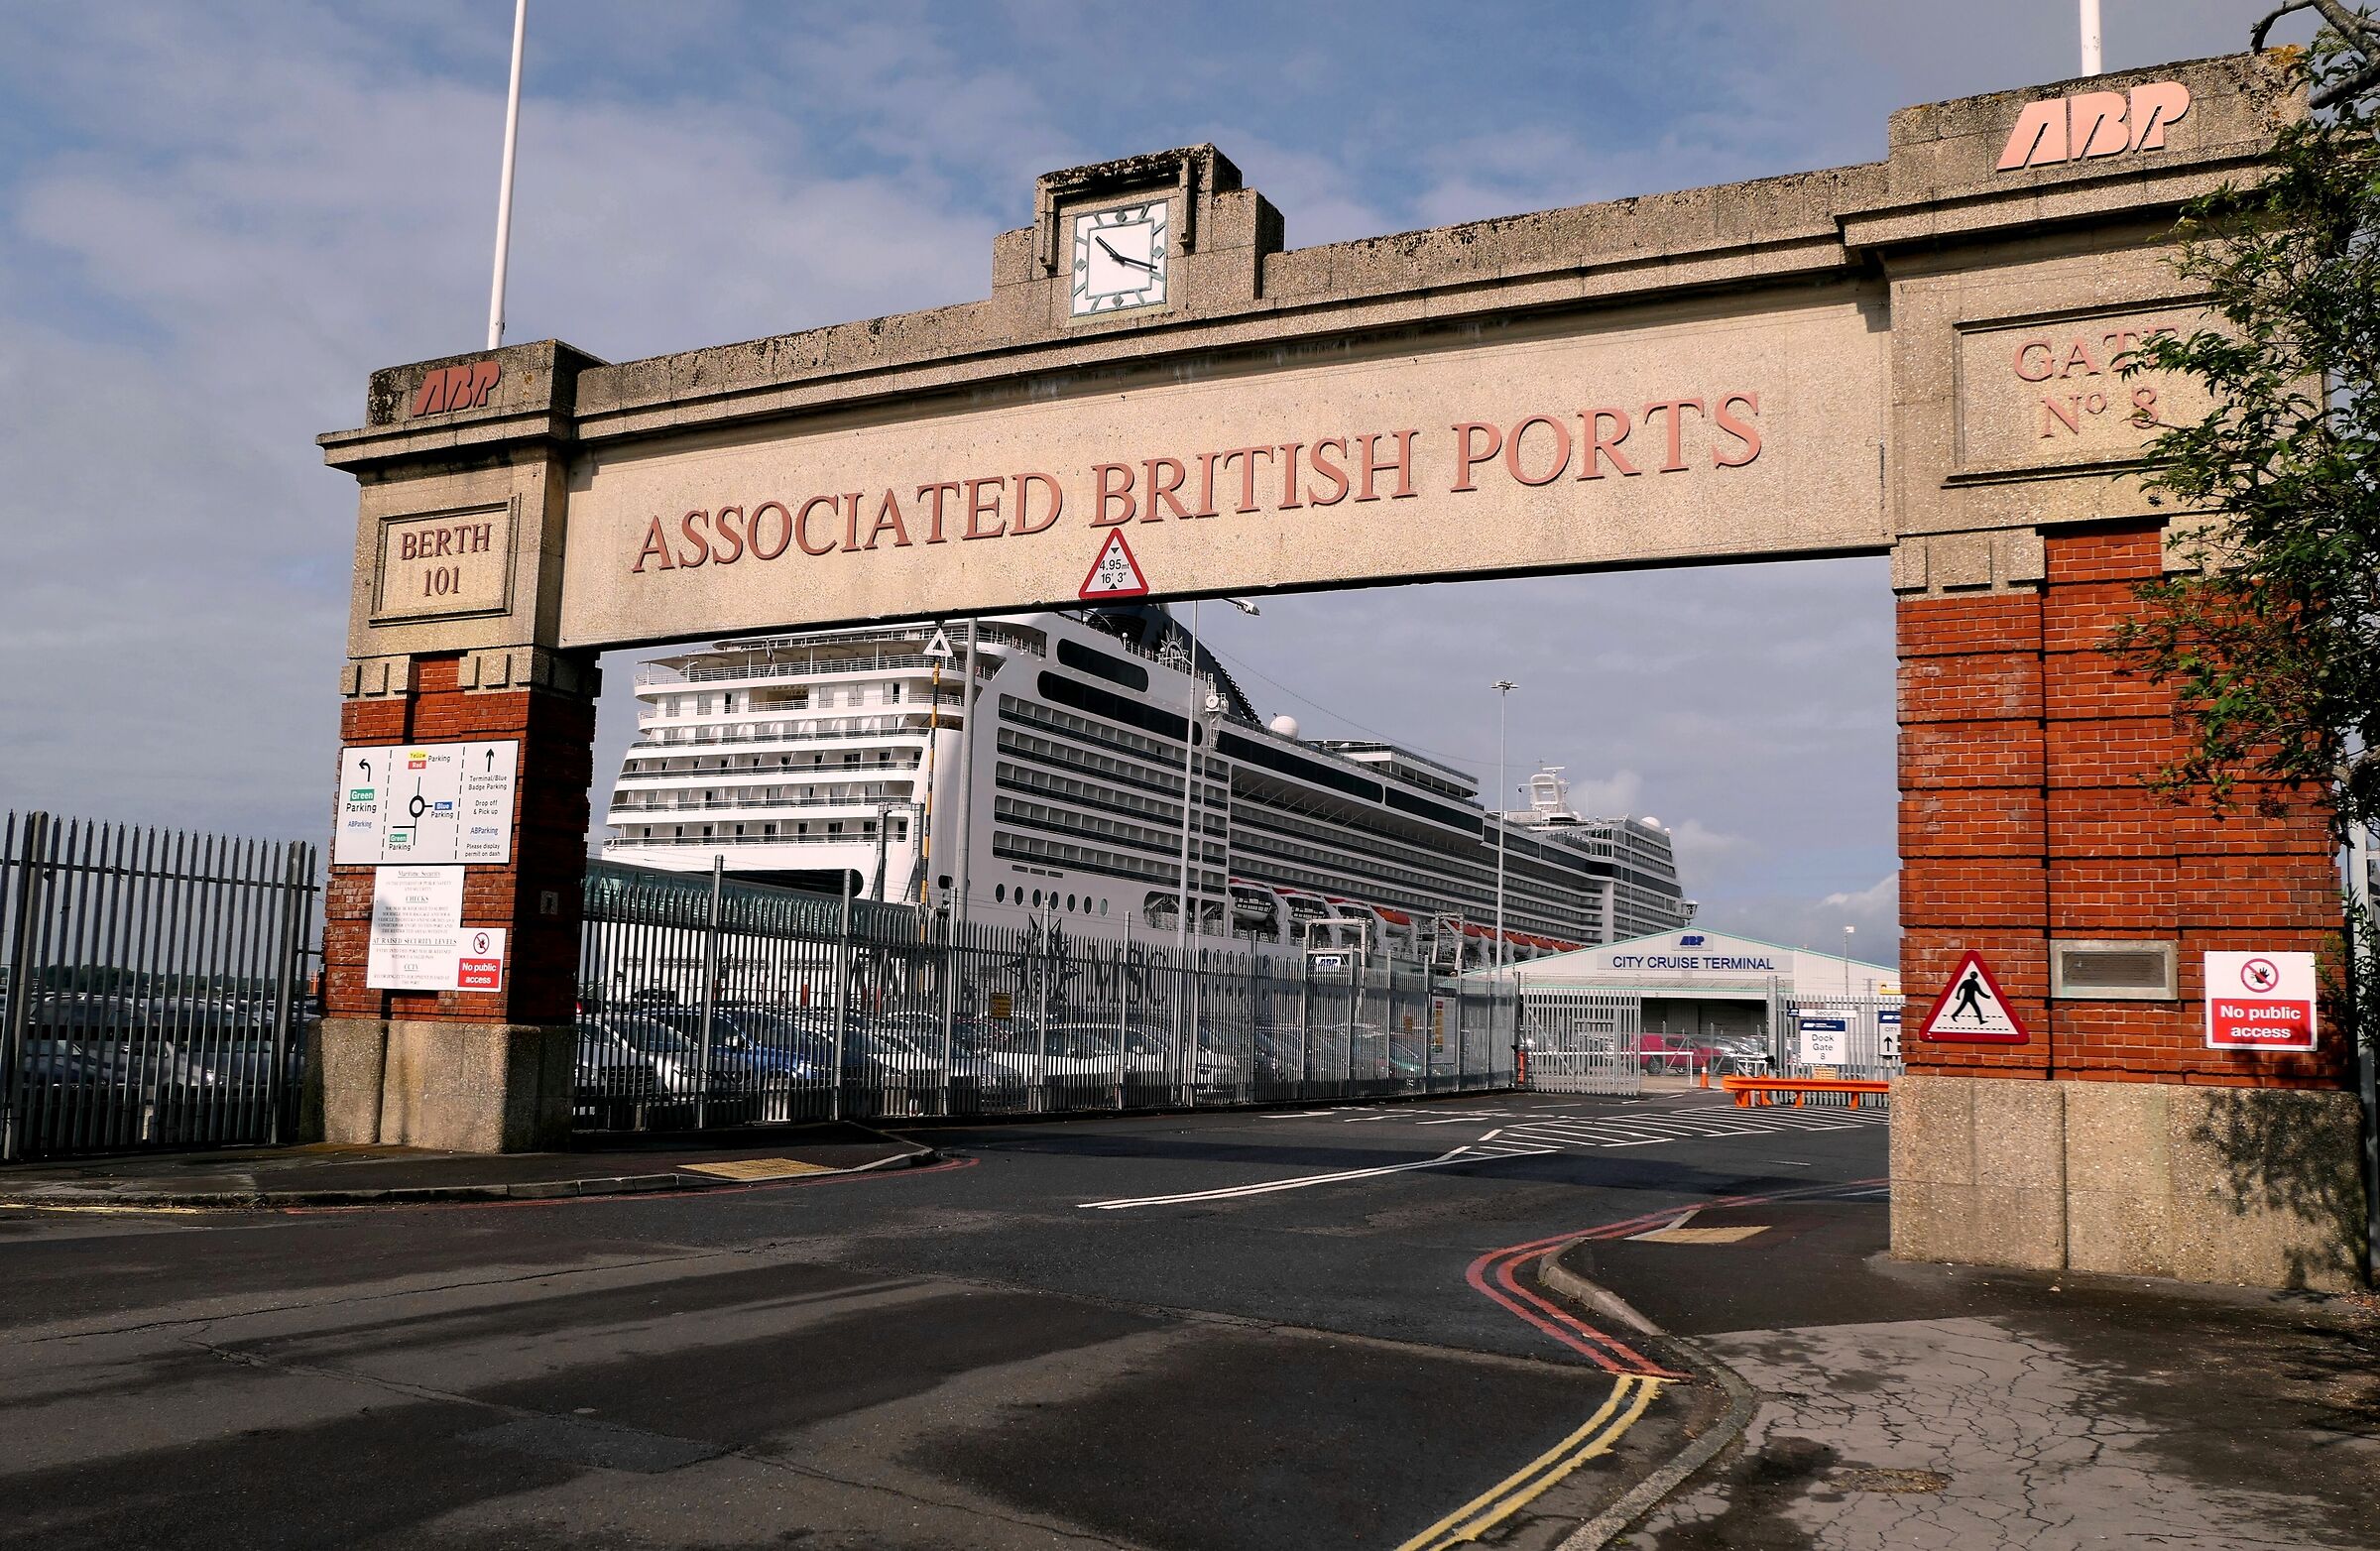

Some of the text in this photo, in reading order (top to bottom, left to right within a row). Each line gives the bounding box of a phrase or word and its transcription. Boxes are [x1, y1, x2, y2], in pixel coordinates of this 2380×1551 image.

[1997, 81, 2191, 172] ABP
[412, 359, 501, 418] ABP
[2132, 385, 2159, 429] 8
[631, 391, 1762, 573] ASSOCIATED BRITISH PORTS
[400, 523, 492, 560] BERTH
[422, 566, 460, 597] 101
[351, 790, 373, 799] Green
[346, 802, 377, 813] Parking
[470, 826, 498, 835] ABParking
[462, 962, 496, 973] No public
[1612, 956, 1774, 970] CITY CRUISE TERMINAL
[2220, 1006, 2301, 1021] No public
[1812, 1033, 1835, 1042] Dock
[2230, 1026, 2291, 1038] access
